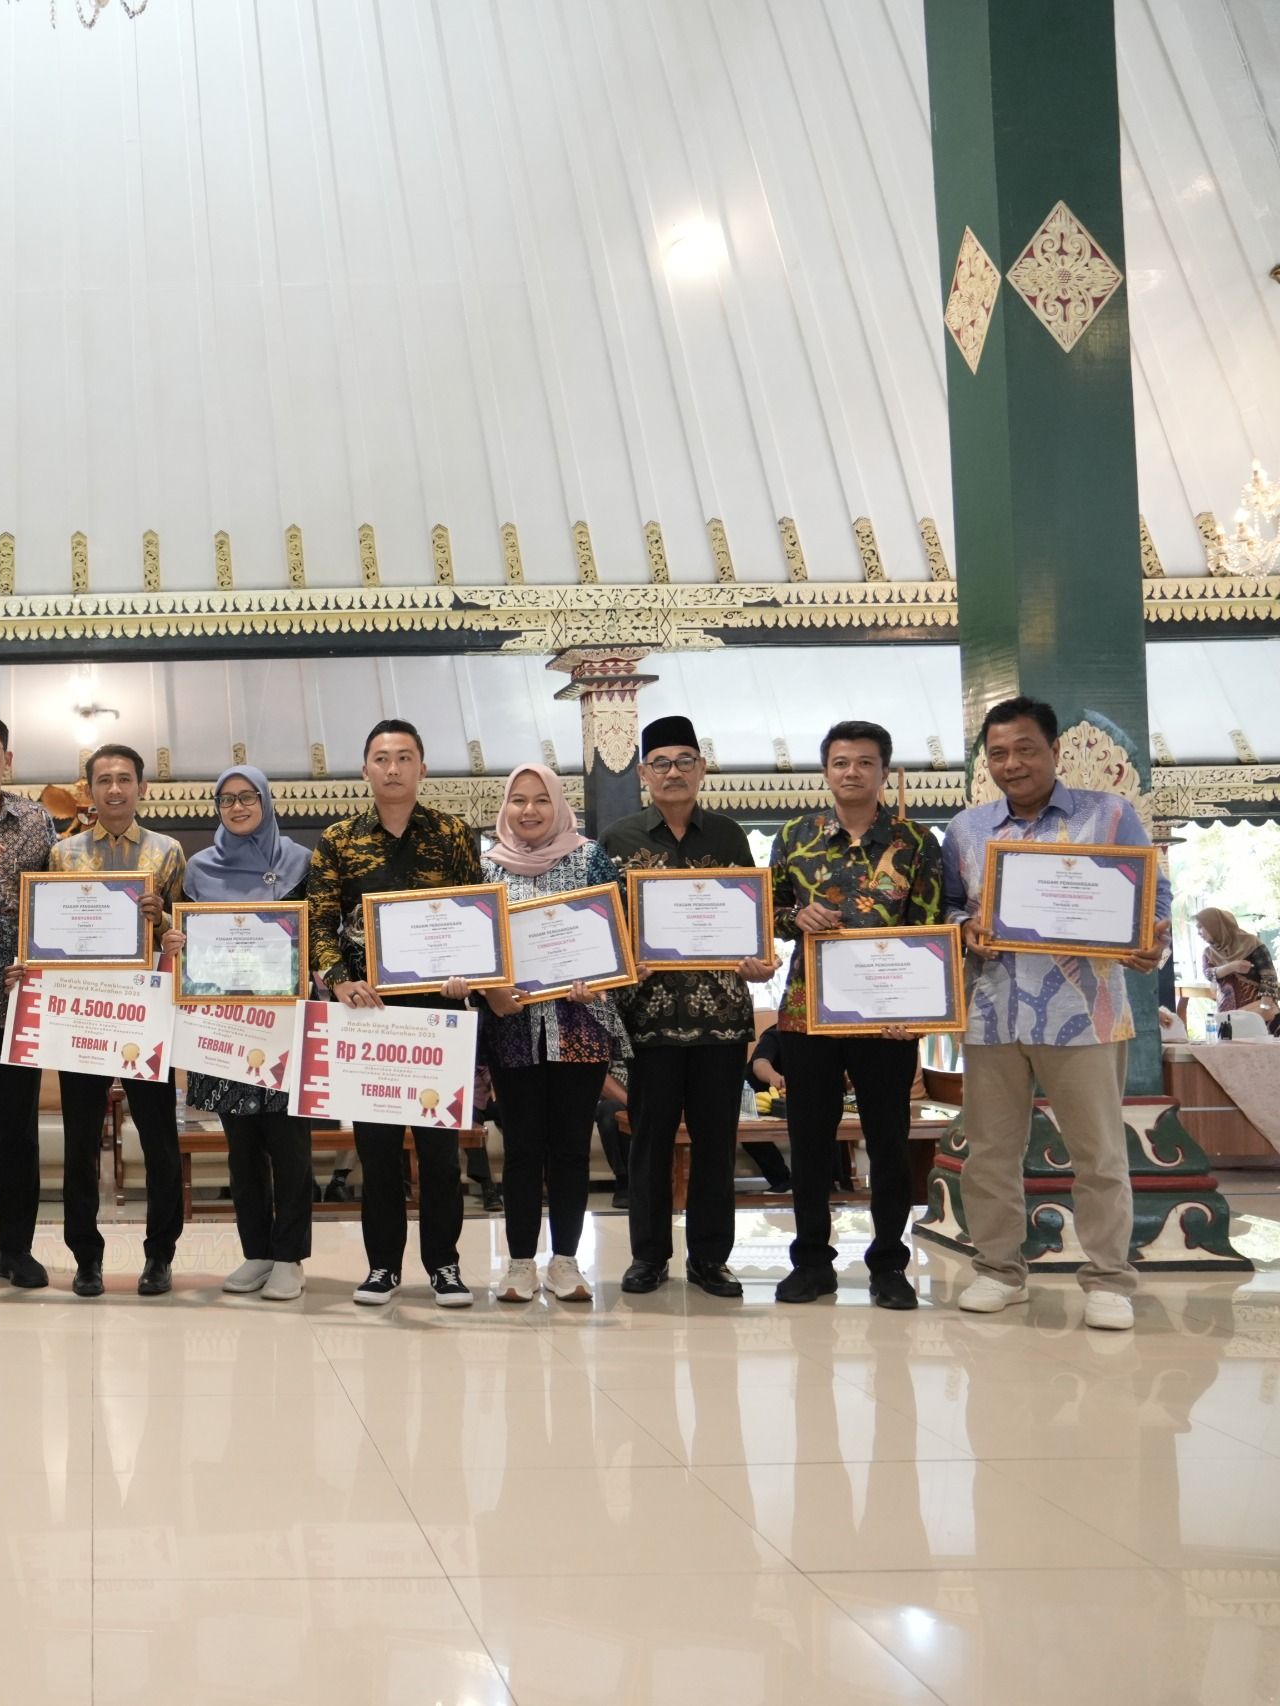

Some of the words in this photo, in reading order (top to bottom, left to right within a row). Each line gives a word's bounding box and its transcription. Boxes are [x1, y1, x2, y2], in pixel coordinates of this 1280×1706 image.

[47, 994, 66, 1016] Rp
[70, 998, 146, 1022] 4.500.000
[201, 1004, 276, 1029] 3.500.000
[71, 1036, 108, 1052] TERBAIK
[113, 1040, 118, 1052] I
[197, 1036, 234, 1055] TERBAIK
[238, 1045, 246, 1058] II
[336, 1040, 356, 1062] Rp
[361, 1042, 443, 1066] 2.000.000
[360, 1083, 402, 1099] TERBAIK
[407, 1087, 417, 1100] III
